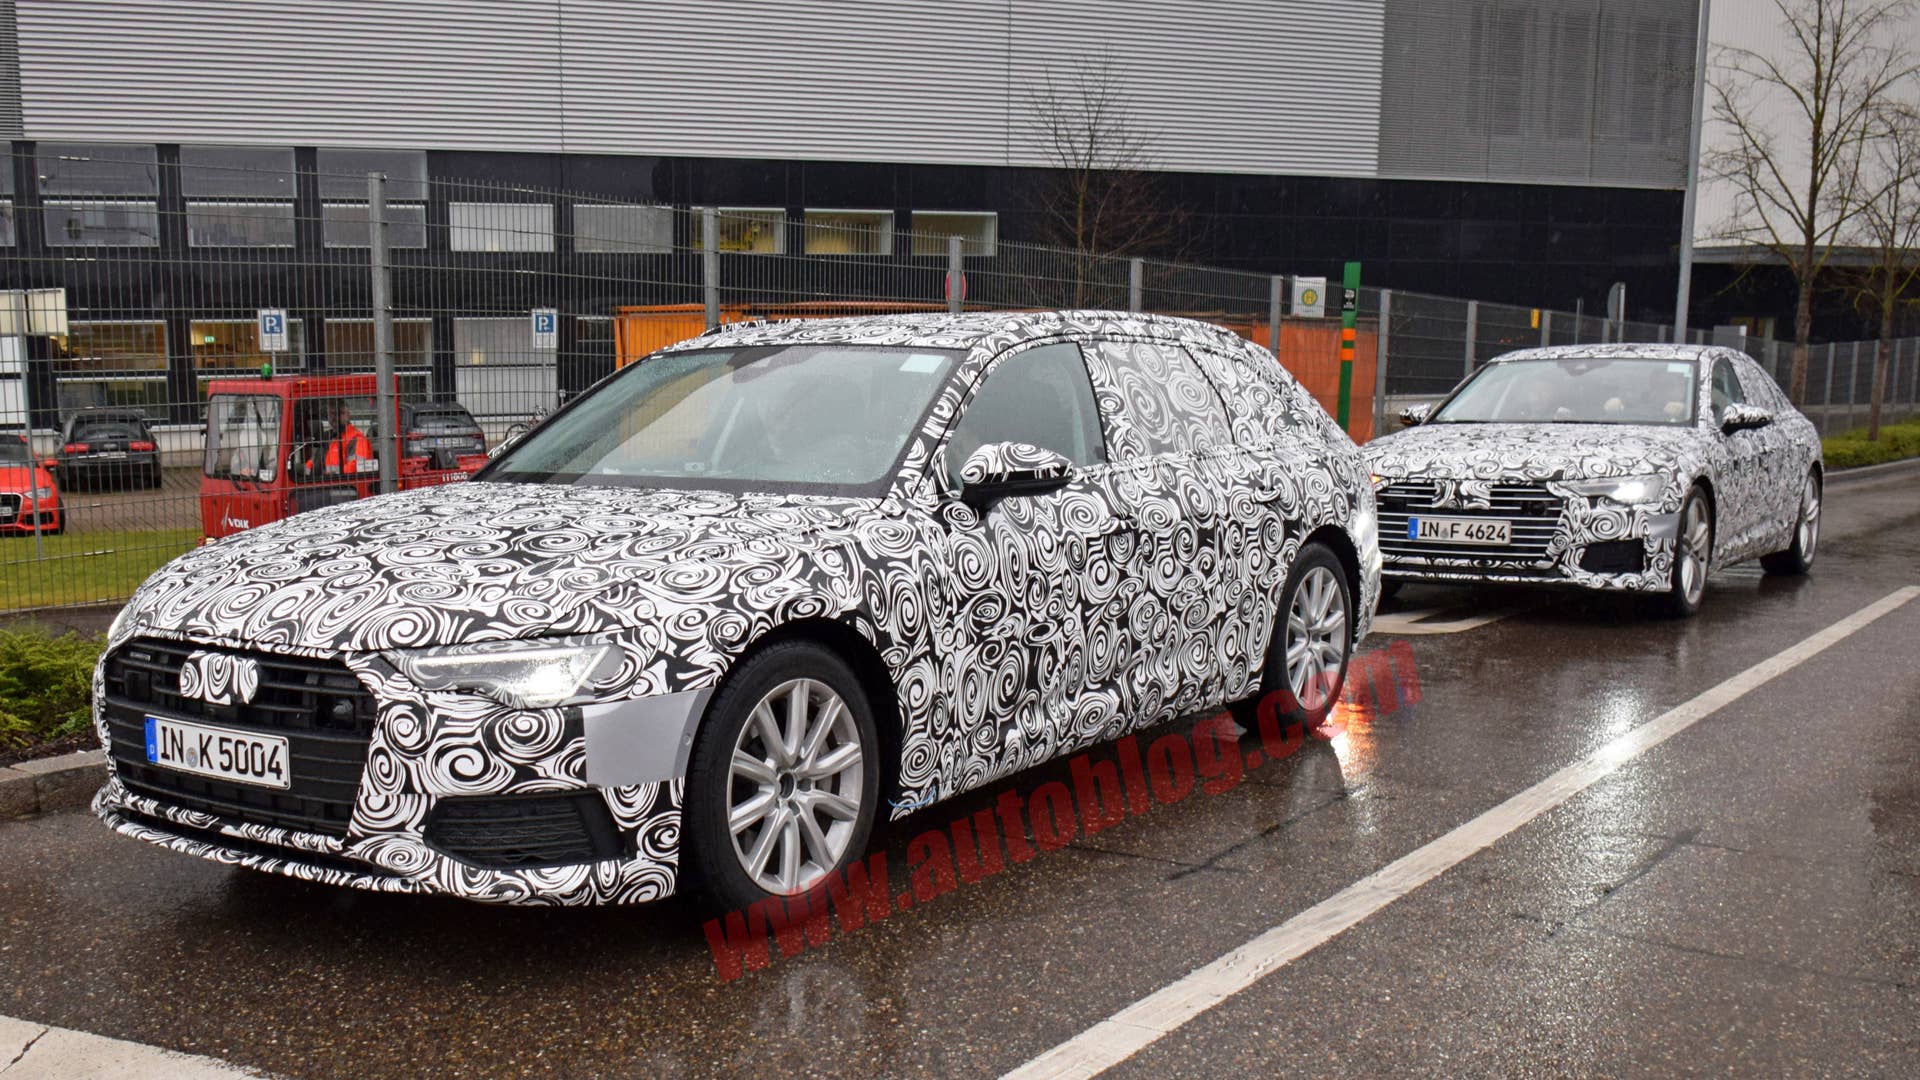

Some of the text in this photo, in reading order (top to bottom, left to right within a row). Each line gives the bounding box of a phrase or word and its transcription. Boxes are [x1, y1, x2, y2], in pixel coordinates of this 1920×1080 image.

[1420, 521, 1507, 541] IN F 4624
[161, 725, 283, 780] IN K 5004
